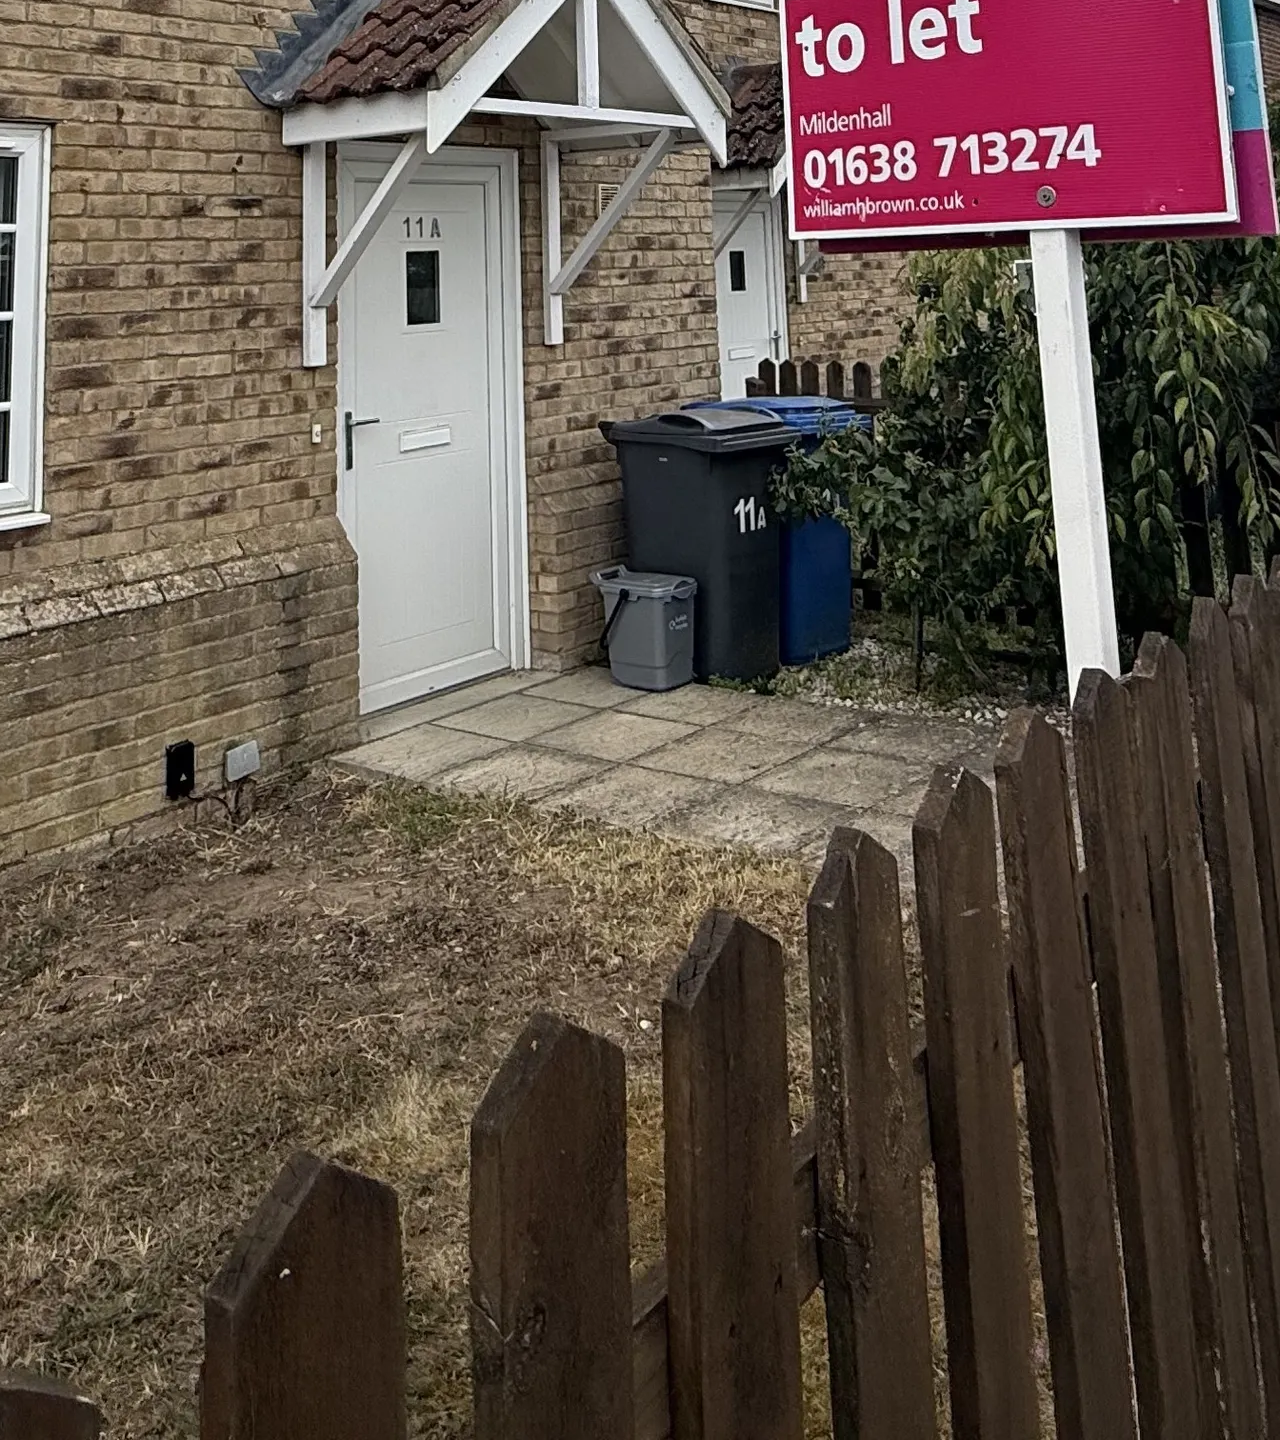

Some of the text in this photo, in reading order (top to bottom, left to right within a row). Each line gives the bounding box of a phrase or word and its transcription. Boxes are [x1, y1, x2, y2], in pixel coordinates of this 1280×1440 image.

[795, 14, 865, 77] to
[799, 103, 892, 136] Mildenhall
[803, 124, 1101, 189] 01638 713274
[803, 190, 964, 218] williamhbrown.co.uk
[402, 216, 441, 238] 11A
[733, 496, 767, 533] 11A
